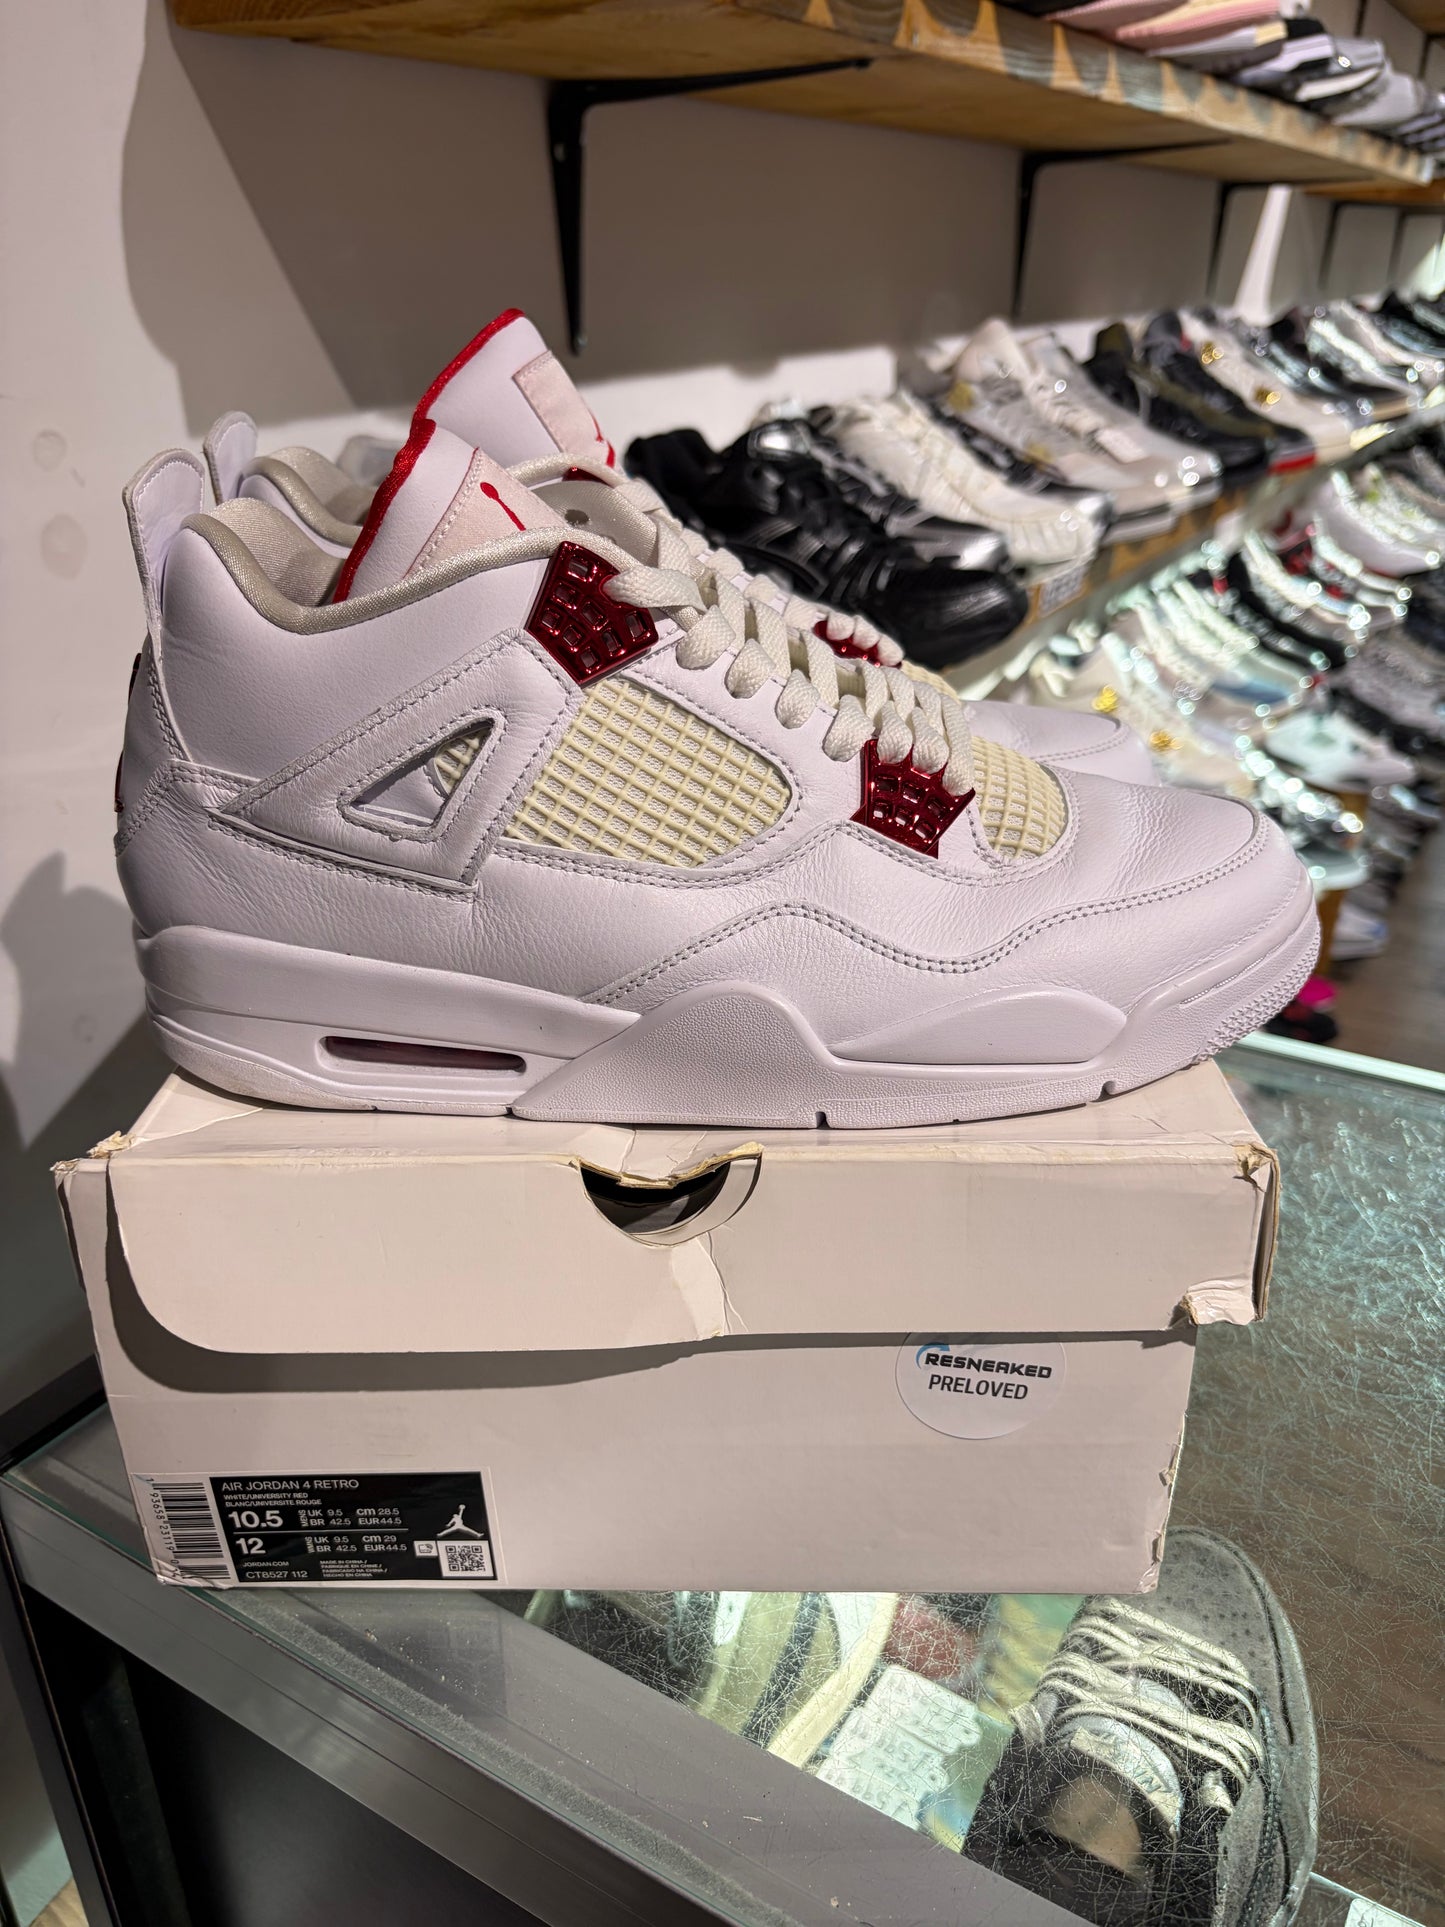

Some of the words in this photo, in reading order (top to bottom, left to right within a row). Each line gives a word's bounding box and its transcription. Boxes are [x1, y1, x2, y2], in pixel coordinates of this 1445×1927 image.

[924, 1352, 1053, 1379] RESNEAKED
[928, 1374, 1028, 1400] PRELOVED
[221, 1482, 243, 1491] AIR
[246, 1480, 300, 1491] JORDAN
[303, 1480, 311, 1490] 4
[314, 1479, 359, 1489] RETRO
[228, 1510, 283, 1528] 10.5
[307, 1509, 323, 1517] UK
[327, 1508, 343, 1516] 9.5
[356, 1507, 376, 1516] cm
[378, 1507, 400, 1516] 28.5
[149, 1492, 165, 1520] 93658
[159, 1525, 175, 1551] 23119
[309, 1518, 326, 1526] BR
[329, 1518, 351, 1526] 42.5
[235, 1537, 266, 1554] 12
[314, 1536, 330, 1544] UK
[362, 1535, 381, 1543] cm
[383, 1535, 397, 1543] 29
[246, 1570, 288, 1579] CT8527
[291, 1570, 309, 1578] 112
